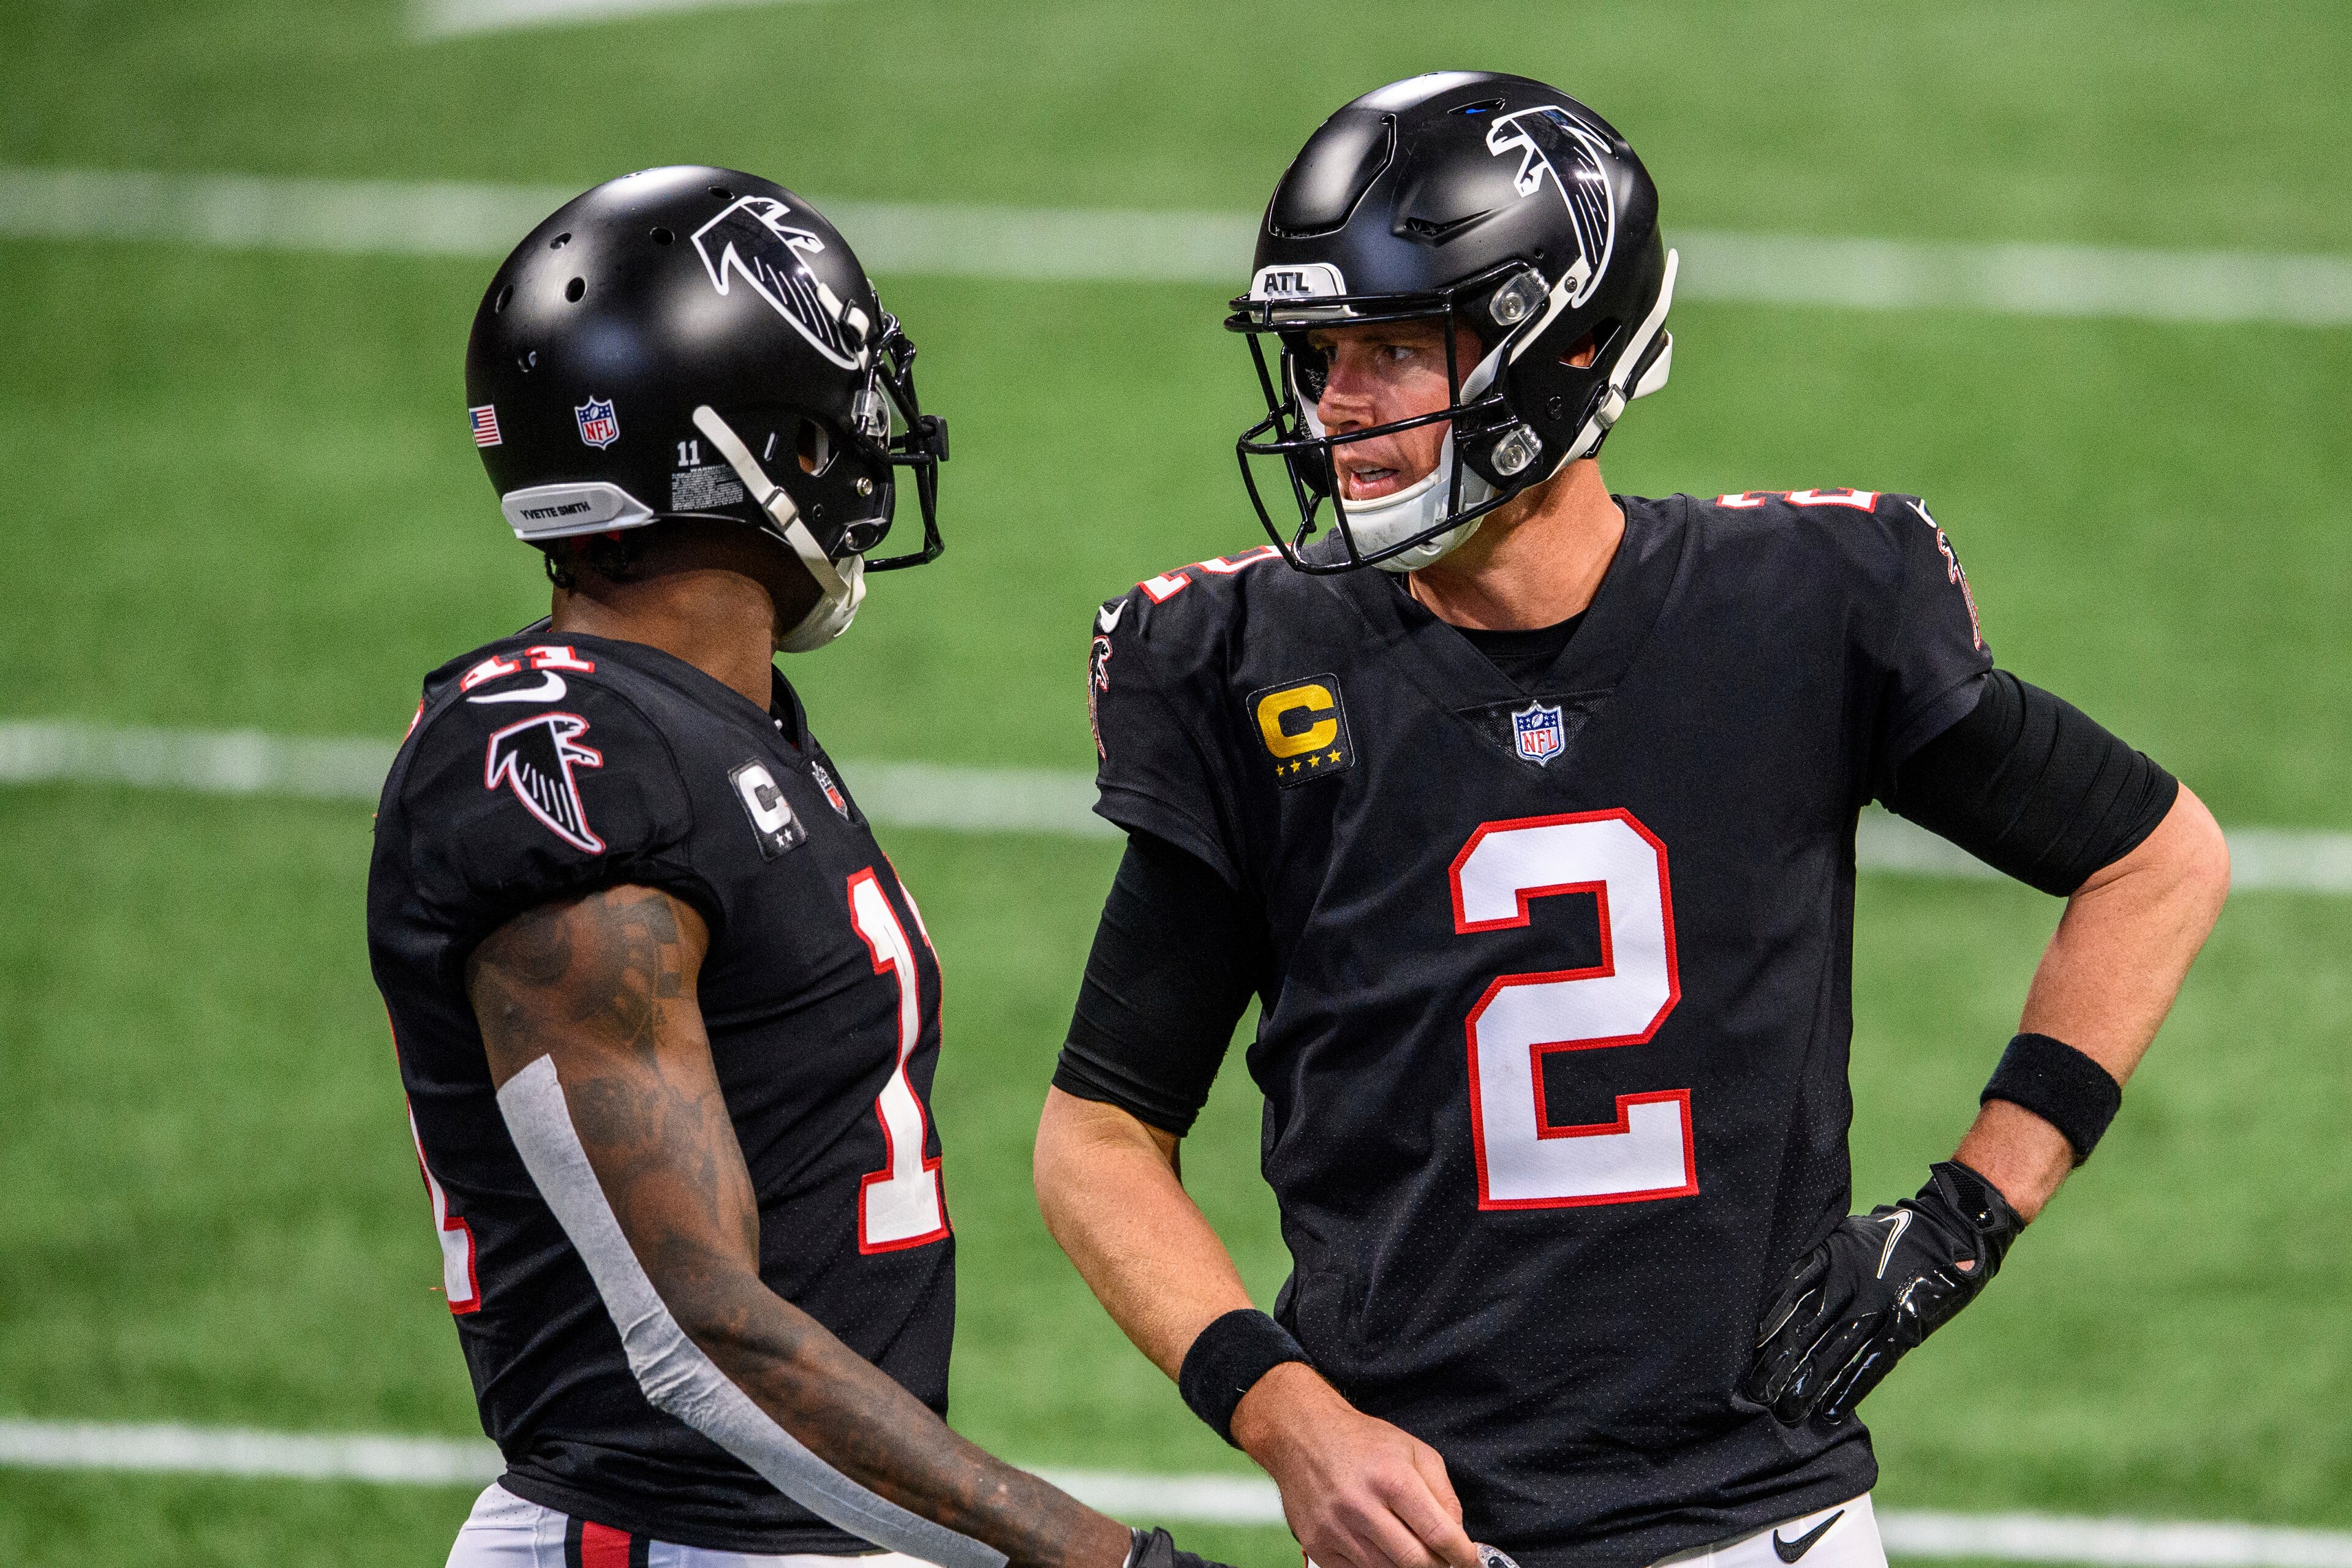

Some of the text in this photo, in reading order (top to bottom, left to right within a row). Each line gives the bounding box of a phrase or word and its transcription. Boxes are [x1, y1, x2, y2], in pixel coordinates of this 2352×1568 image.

[1264, 272, 1310, 292] ATL
[584, 420, 614, 440] NFL
[677, 440, 700, 466] 11
[519, 501, 591, 520] YVETTE SMITH
[1257, 684, 1338, 758] C
[1522, 729, 1558, 754] NFL
[739, 765, 792, 834] C
[1448, 807, 1699, 1211] 2
